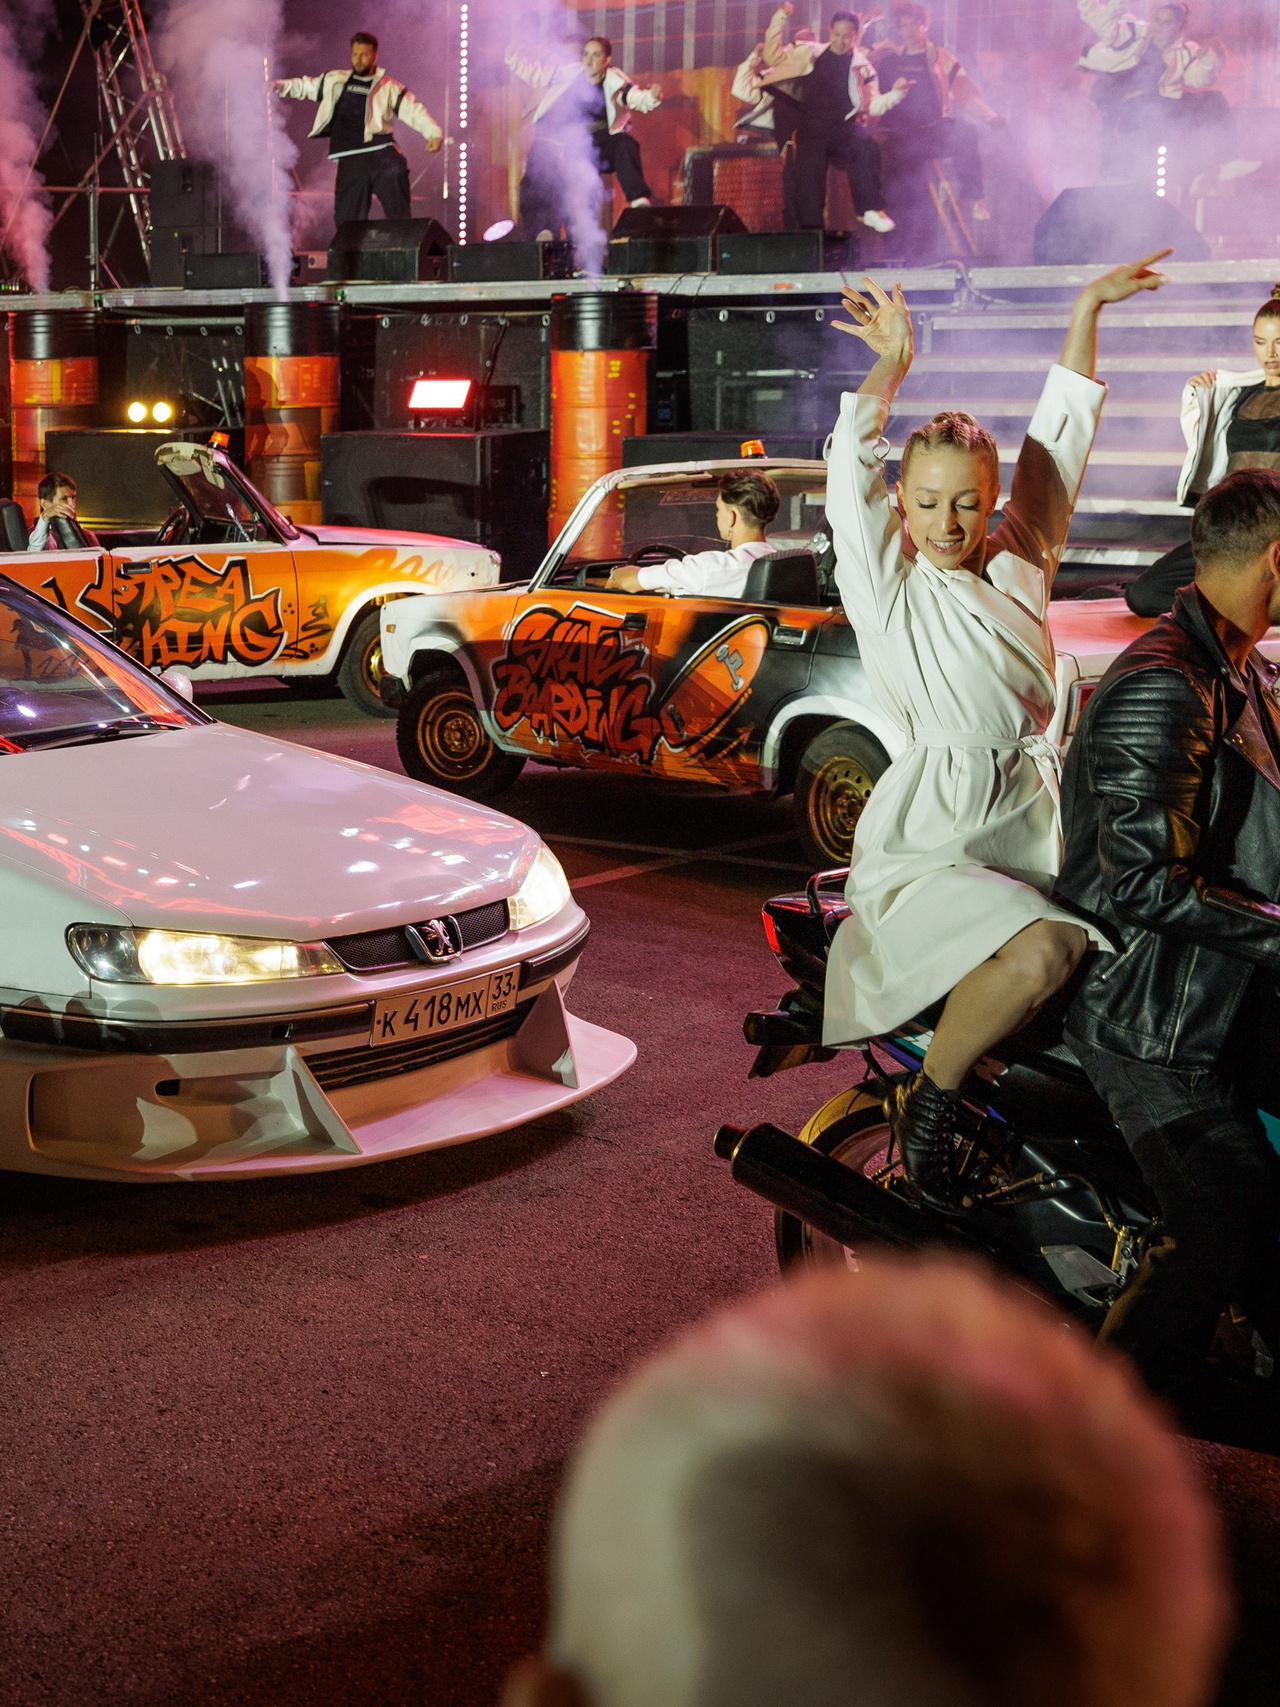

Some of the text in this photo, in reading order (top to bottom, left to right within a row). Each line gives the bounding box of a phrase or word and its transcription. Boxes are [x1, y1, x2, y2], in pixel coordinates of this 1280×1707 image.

[141, 600, 288, 668] KING
[512, 606, 646, 686] SKATE
[491, 1000, 507, 1013] RUS
[492, 971, 514, 1000] 33
